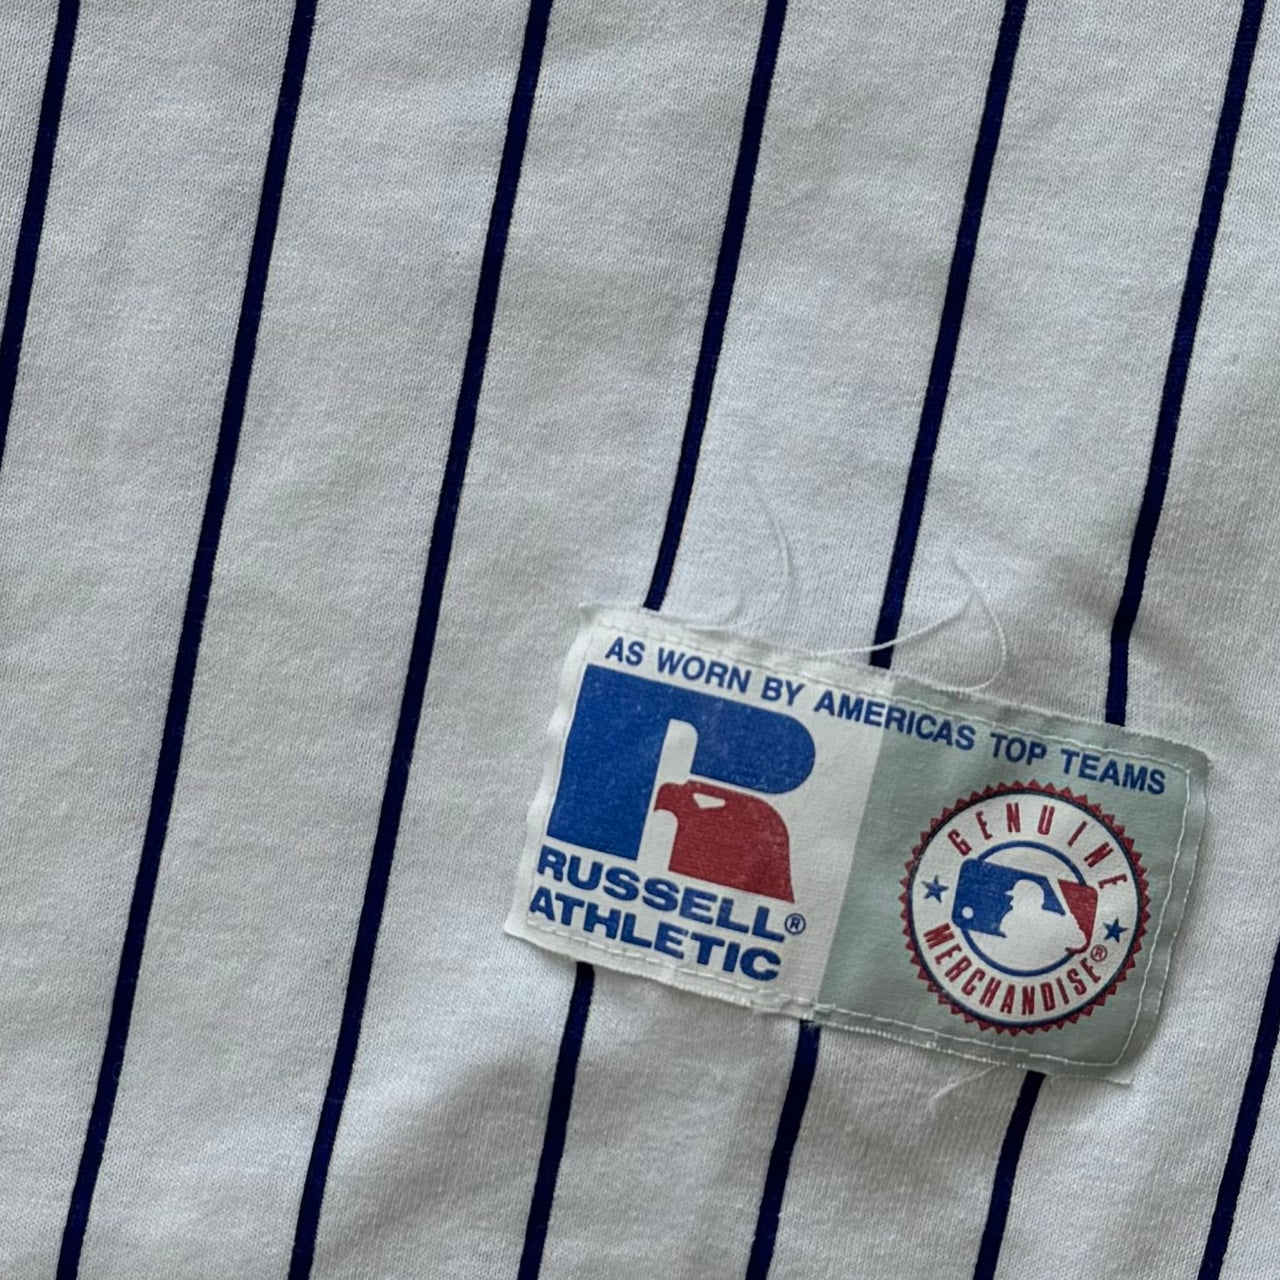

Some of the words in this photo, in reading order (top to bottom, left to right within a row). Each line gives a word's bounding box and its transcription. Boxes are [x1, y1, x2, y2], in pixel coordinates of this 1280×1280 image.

[605, 636, 645, 667] AS
[657, 648, 752, 694] WORN
[760, 676, 806, 707] BY
[813, 690, 976, 751] AMERICAS
[990, 731, 1048, 766] TOP
[1060, 747, 1166, 795] TEAMS
[947, 802, 1128, 890] GENUINE
[529, 885, 782, 982] ATHLETIC
